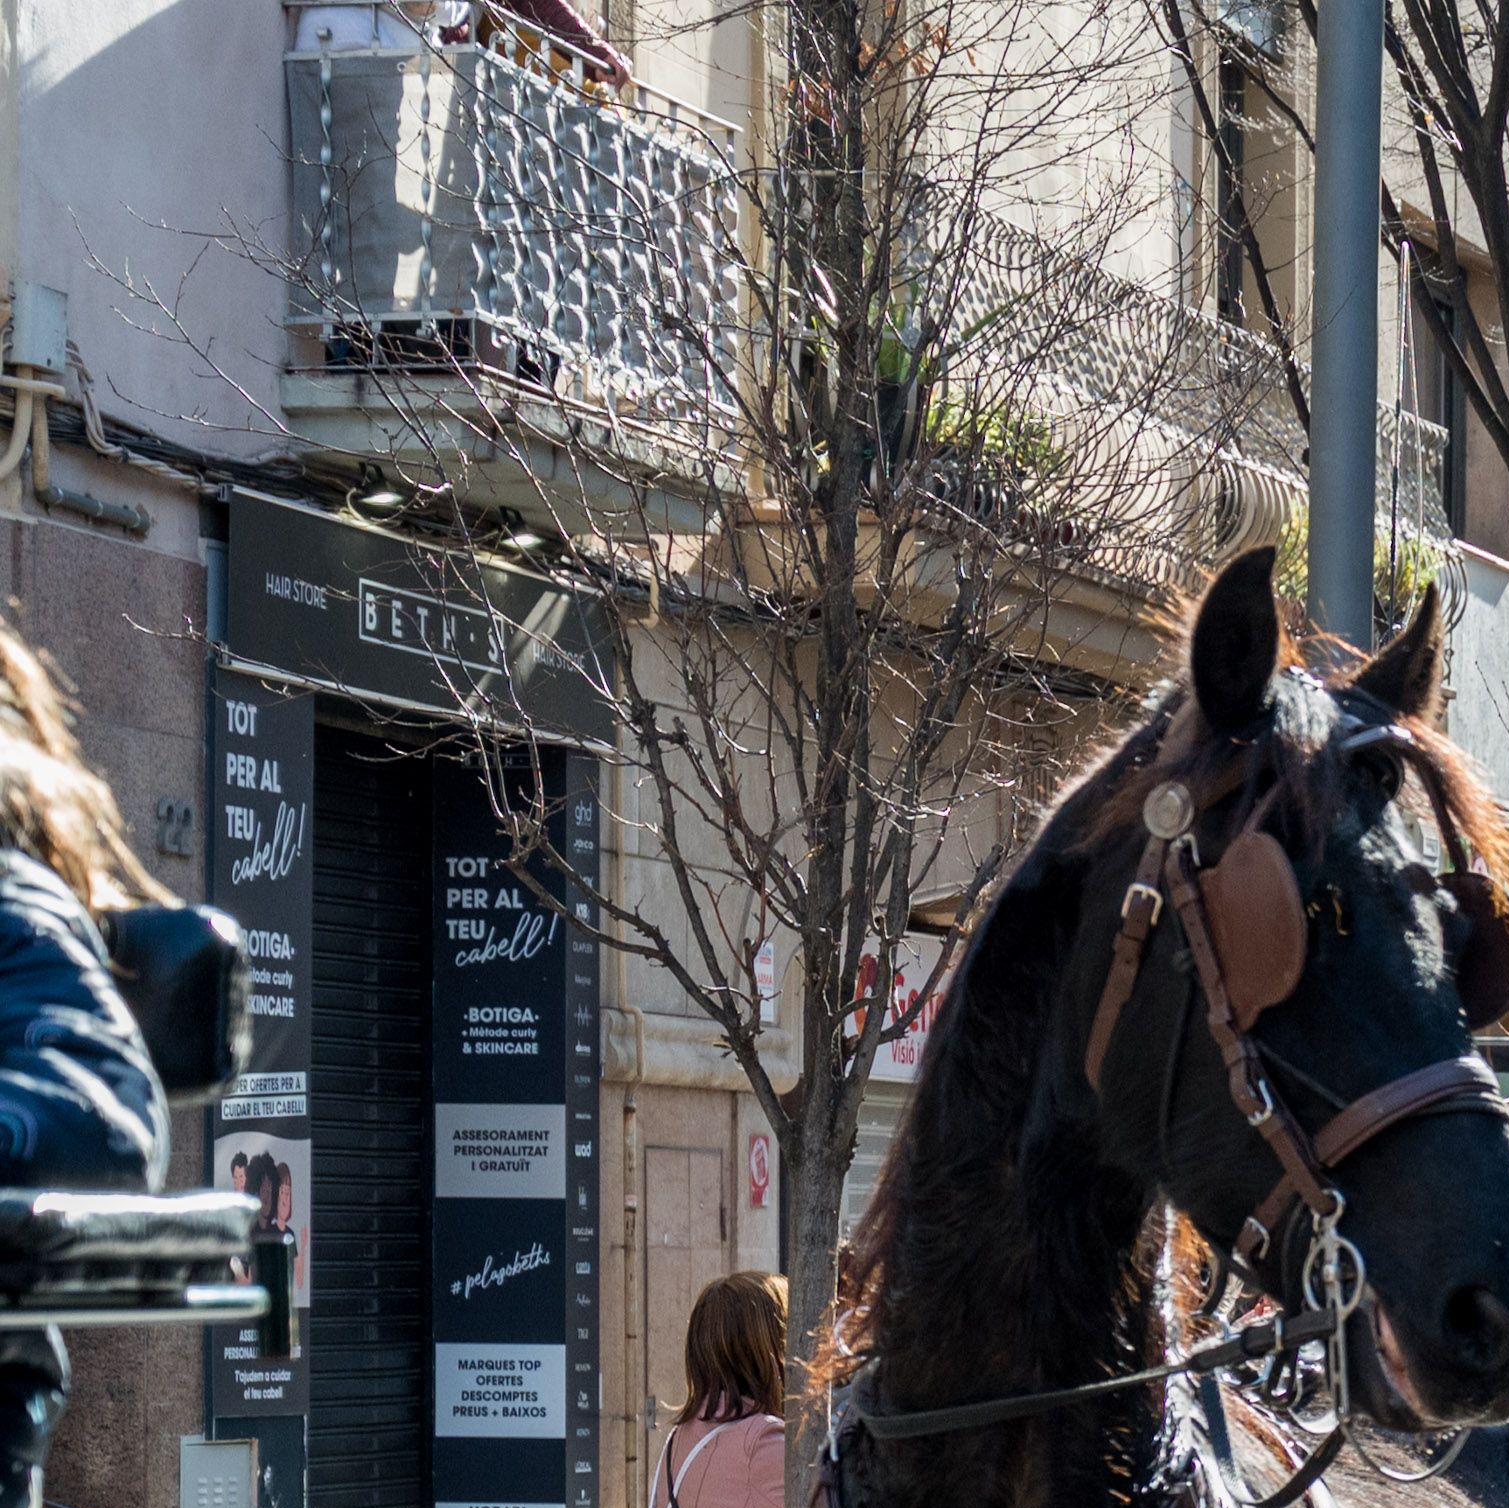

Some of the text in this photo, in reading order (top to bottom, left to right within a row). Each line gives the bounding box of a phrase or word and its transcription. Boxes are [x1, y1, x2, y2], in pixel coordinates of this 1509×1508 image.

[266, 573, 327, 610] HAIR STORE
[226, 700, 257, 737] TOT
[226, 753, 281, 793] PER AL
[225, 805, 255, 841] TEU
[232, 801, 305, 885] cabell!
[446, 857, 488, 877] TOT
[447, 889, 523, 909] PER AL
[446, 920, 485, 940] TEU
[455, 911, 558, 967] cabell!
[249, 966, 293, 990] tode curly
[511, 1028, 537, 1040] curly
[463, 1042, 538, 1055] & SKINCARE
[891, 1040, 915, 1064] Visió
[250, 1078, 279, 1091] OFERTES
[281, 1077, 294, 1090] PER
[295, 1077, 301, 1089] A
[223, 1100, 305, 1117] CUIDAR EL TEU CABELL!
[453, 1130, 549, 1142] ASSESORAMENT
[454, 1145, 548, 1157] PERSONALITZAT
[471, 1159, 530, 1172] I GRATUÏT
[458, 1359, 541, 1372] MARQUES TOP
[265, 1372, 270, 1381] a
[271, 1369, 291, 1381] cuidar
[476, 1375, 523, 1387] OFERTES
[461, 1391, 538, 1402] DESCOMPTES
[453, 1406, 488, 1418] PREUS
[502, 1406, 547, 1418] BAIXOS
